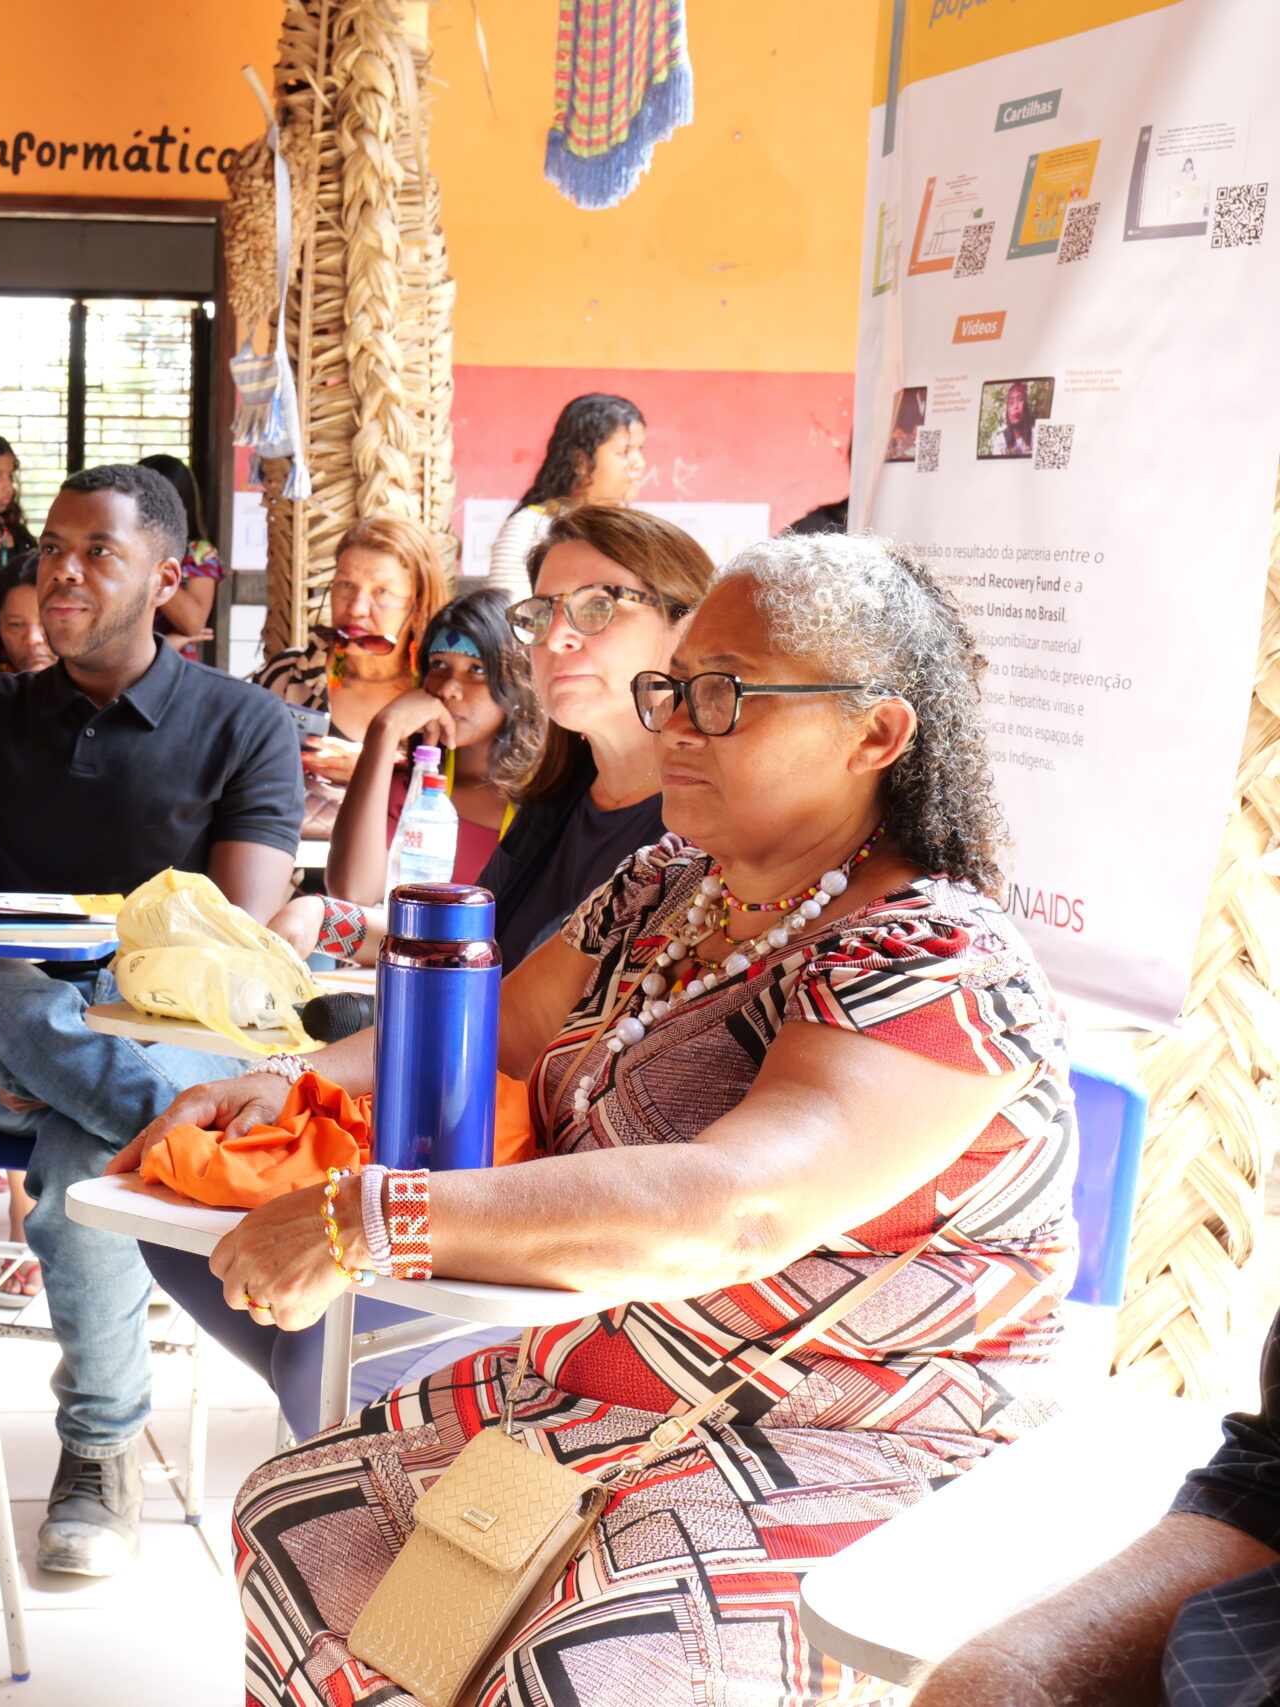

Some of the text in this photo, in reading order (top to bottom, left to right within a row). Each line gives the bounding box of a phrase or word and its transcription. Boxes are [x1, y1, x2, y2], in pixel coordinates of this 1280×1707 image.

[1003, 100, 1053, 123] Cartilhas
[945, 546, 952, 559] o
[953, 543, 1000, 561] resultado
[1001, 544, 1014, 561] da
[1016, 545, 1051, 564] parceria
[1053, 547, 1091, 563] entre
[1094, 551, 1105, 564] o
[989, 573, 1035, 594] Recovery
[1036, 575, 1061, 592] Fund
[1063, 580, 1072, 593] e
[1074, 580, 1083, 593] a
[987, 602, 1023, 620] Unidas
[1025, 607, 1037, 621] no
[1038, 605, 1068, 624] Brasil,
[1041, 637, 1081, 654] material
[1001, 664, 1009, 677] o
[1011, 663, 1048, 682] trabalho
[1049, 667, 1061, 683] de
[1062, 672, 1133, 693] prevenção
[1009, 690, 1051, 712] hepatites
[1053, 697, 1076, 716] virais
[1077, 706, 1085, 717] e
[1007, 723, 1014, 736] e
[1016, 724, 1033, 739] nos
[1034, 728, 1070, 747] espaços
[1071, 730, 1084, 747] de
